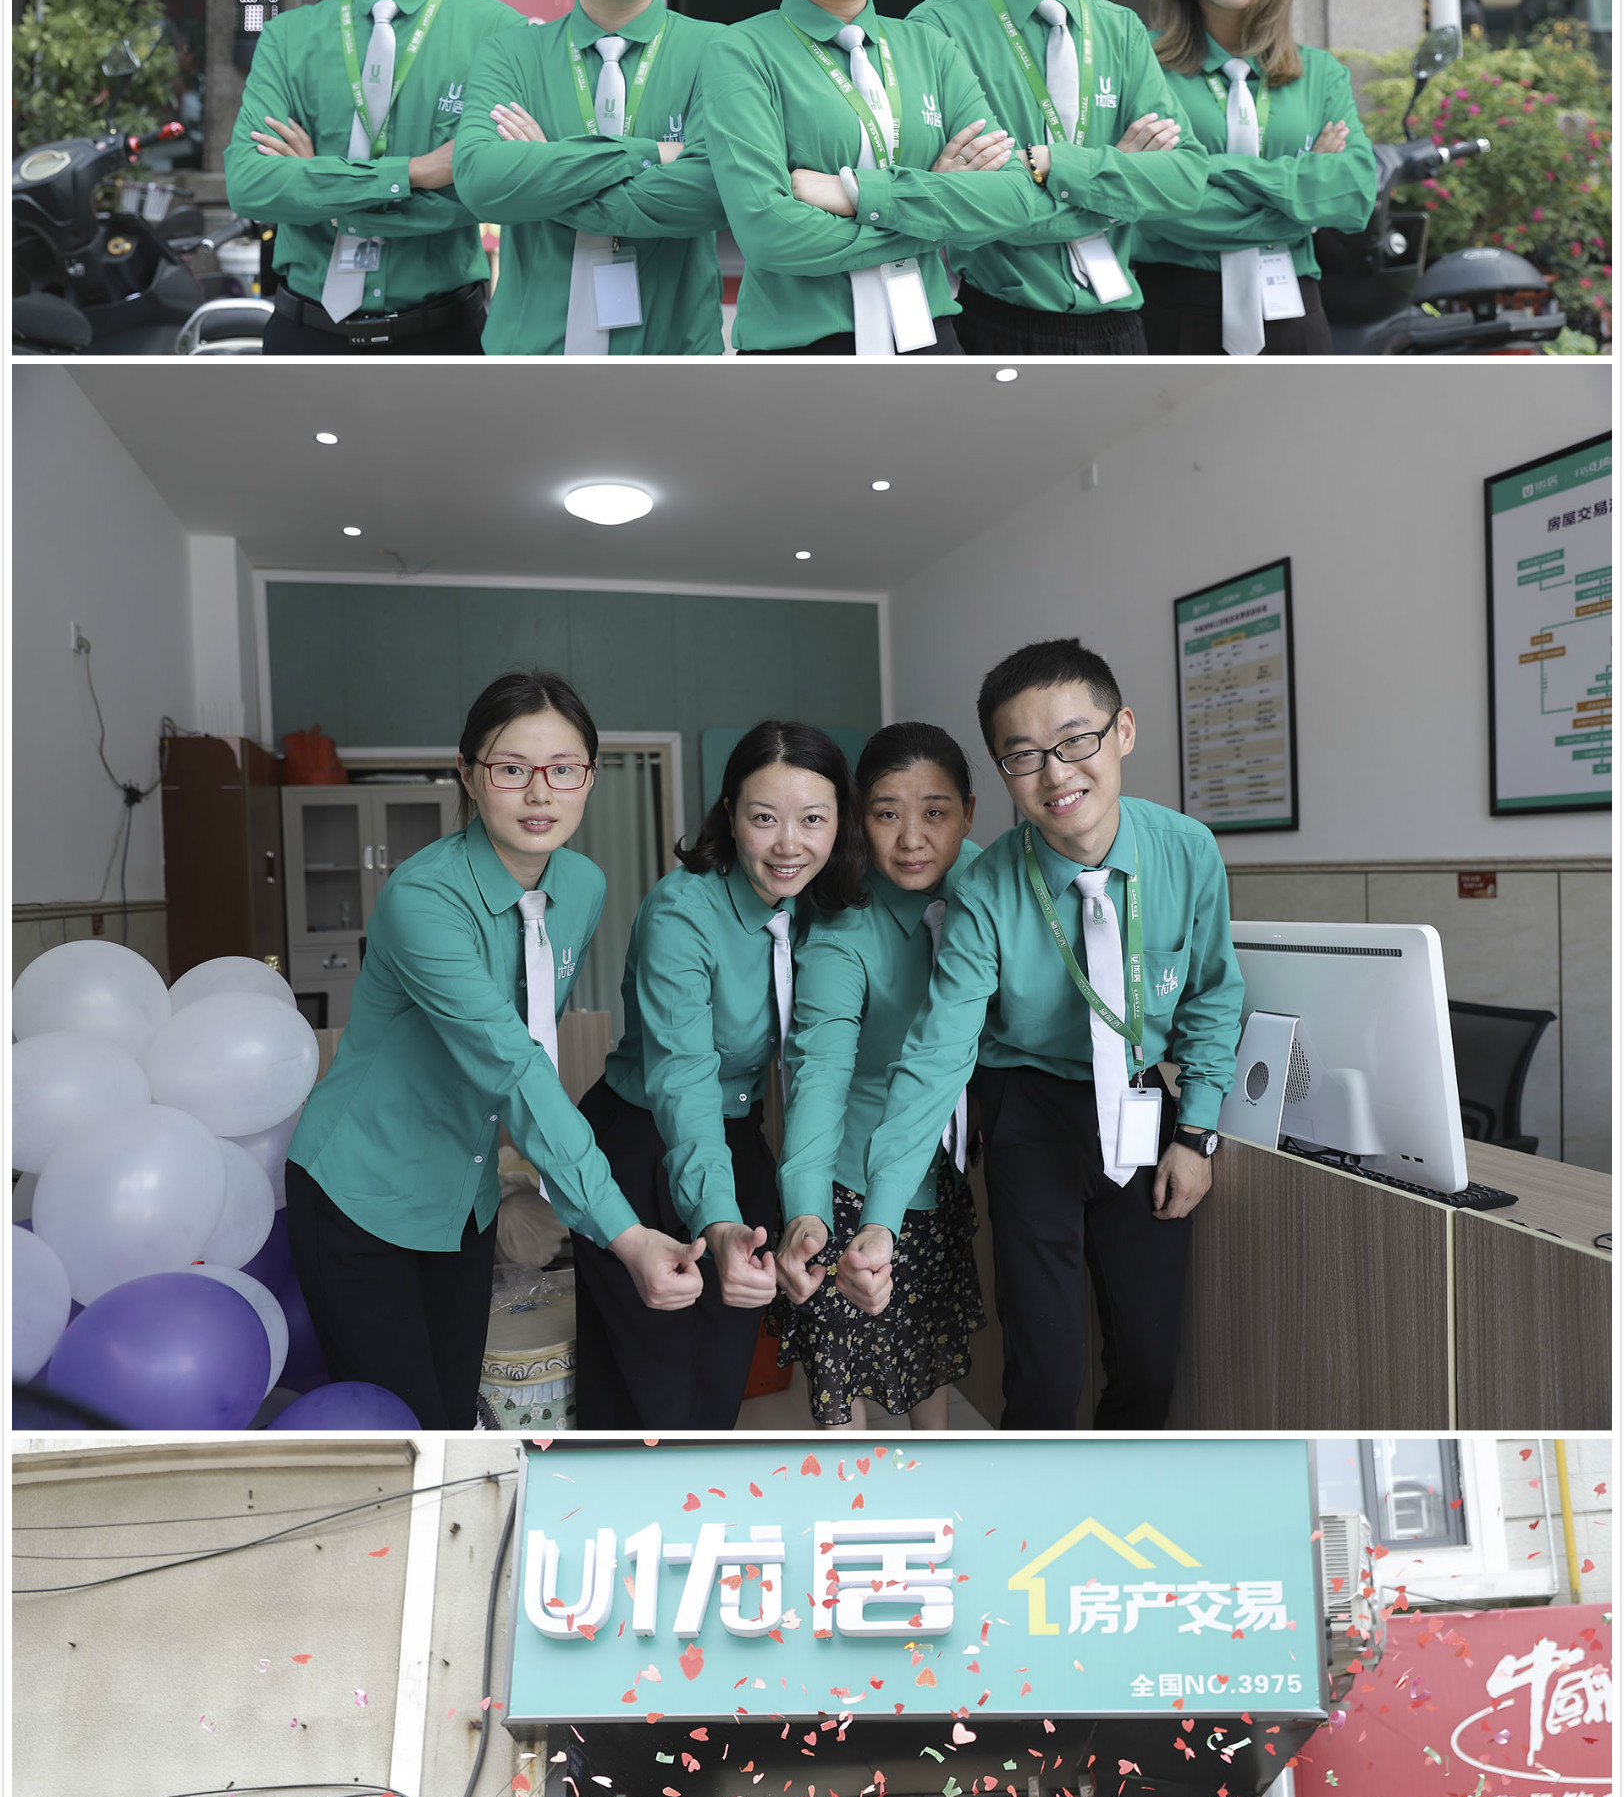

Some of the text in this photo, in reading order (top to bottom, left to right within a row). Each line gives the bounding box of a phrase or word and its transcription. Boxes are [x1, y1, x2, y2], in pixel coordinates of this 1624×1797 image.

[437, 97, 465, 115] 优居
[1067, 1577, 1289, 1637] 房产交易
[1128, 1671, 1304, 1700] 全国NO.3975
